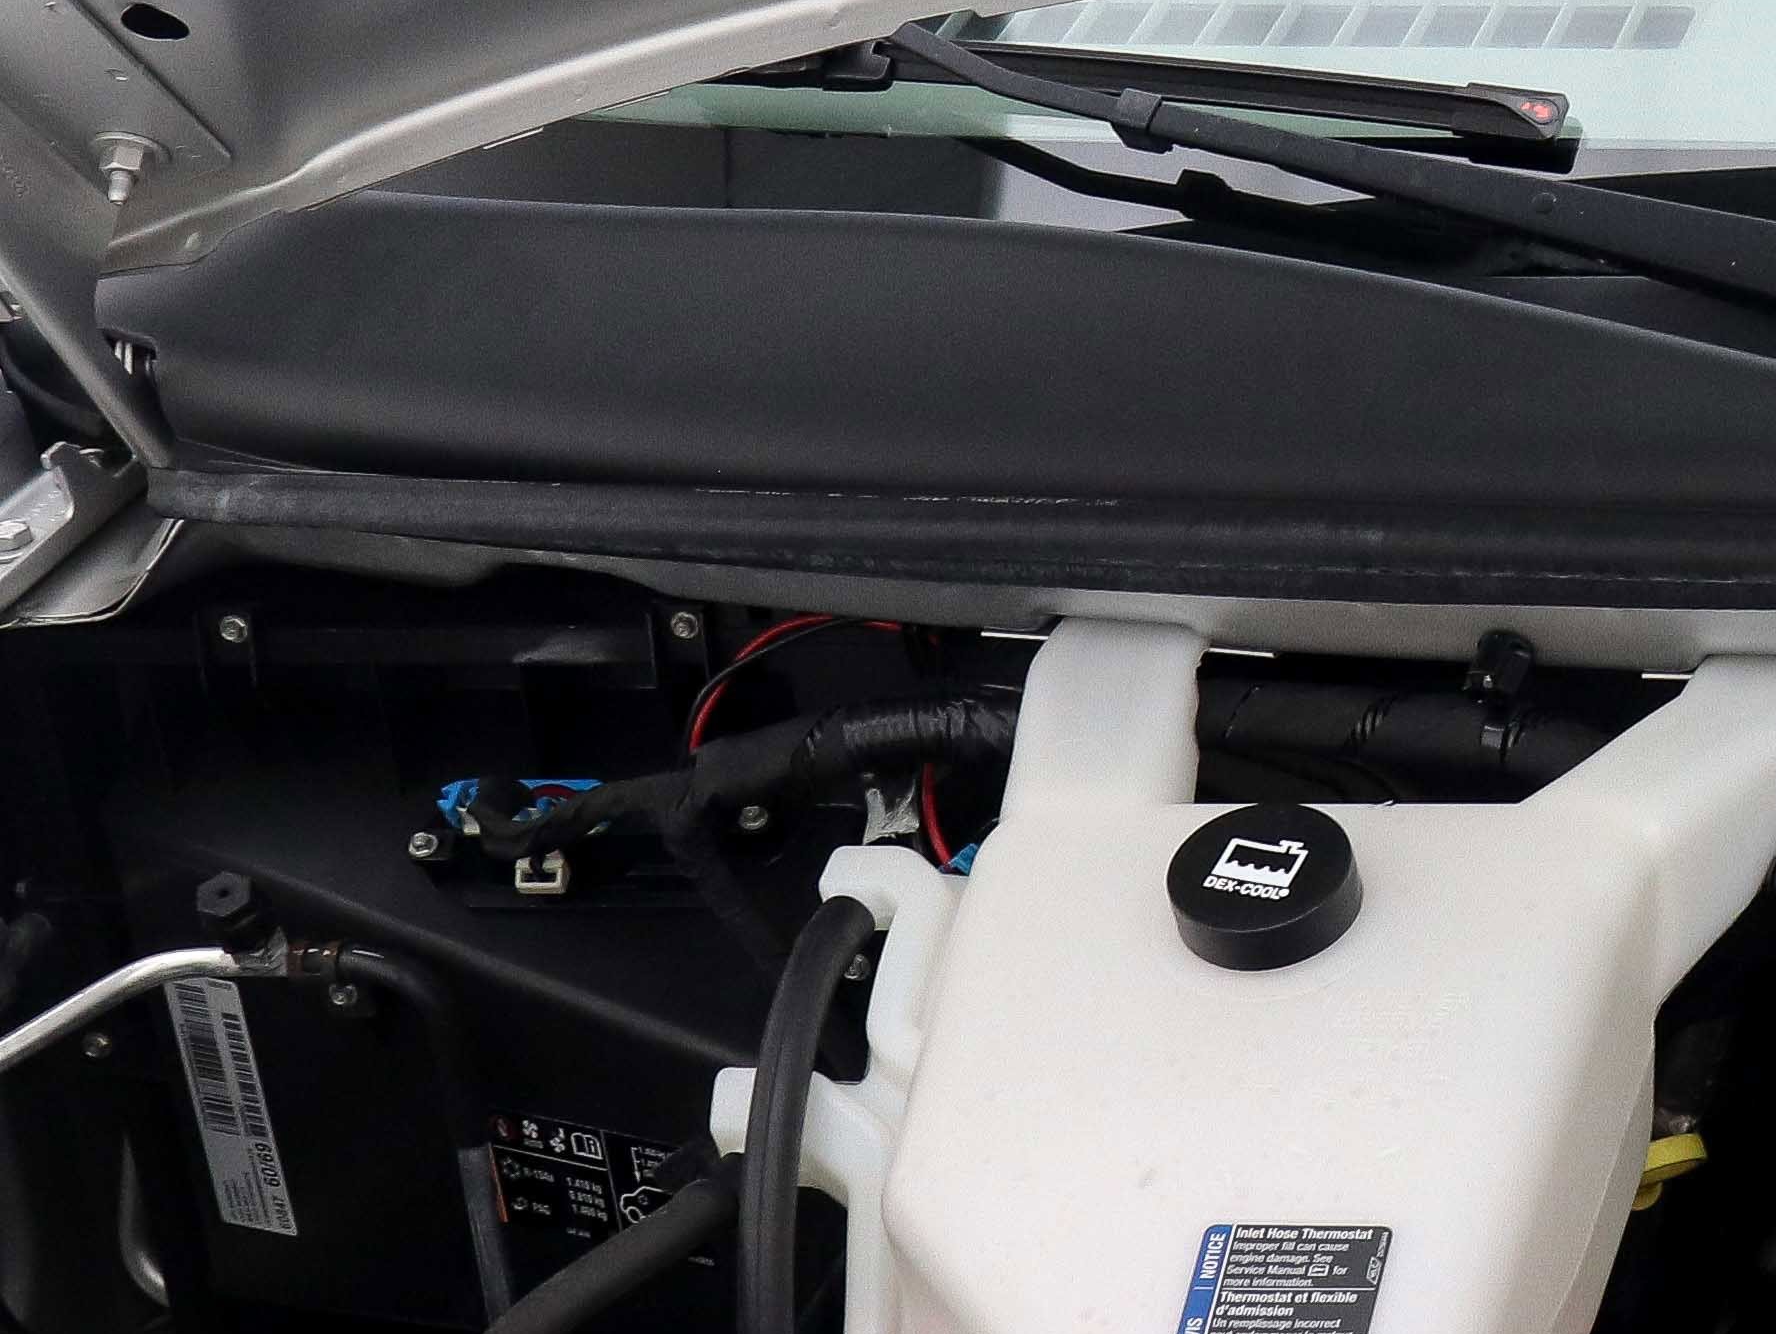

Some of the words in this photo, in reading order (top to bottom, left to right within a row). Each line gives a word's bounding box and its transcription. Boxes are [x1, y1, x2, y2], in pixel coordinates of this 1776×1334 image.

[1236, 1227, 1264, 1239] Inlet
[1266, 1228, 1298, 1240] Hose
[1302, 1228, 1373, 1240] Thermostat
[1232, 1241, 1280, 1252] Improper
[1281, 1242, 1295, 1252] fill
[1296, 1243, 1317, 1252] can
[1317, 1243, 1350, 1252] cause
[1200, 1232, 1227, 1280] NOTICE
[1229, 1255, 1265, 1265] engine
[1266, 1254, 1310, 1265] damage.
[1312, 1254, 1334, 1264] See
[1226, 1265, 1267, 1276] Service
[1266, 1266, 1306, 1276] Manual
[1332, 1266, 1349, 1276] for
[1223, 1278, 1251, 1287] more
[1219, 1291, 1292, 1303] Thermostat
[1294, 1293, 1308, 1303] et
[1310, 1292, 1359, 1304] flexible
[1212, 1318, 1226, 1329] Un
[1228, 1320, 1293, 1331] remplissage
[1294, 1319, 1342, 1329] incorrect
